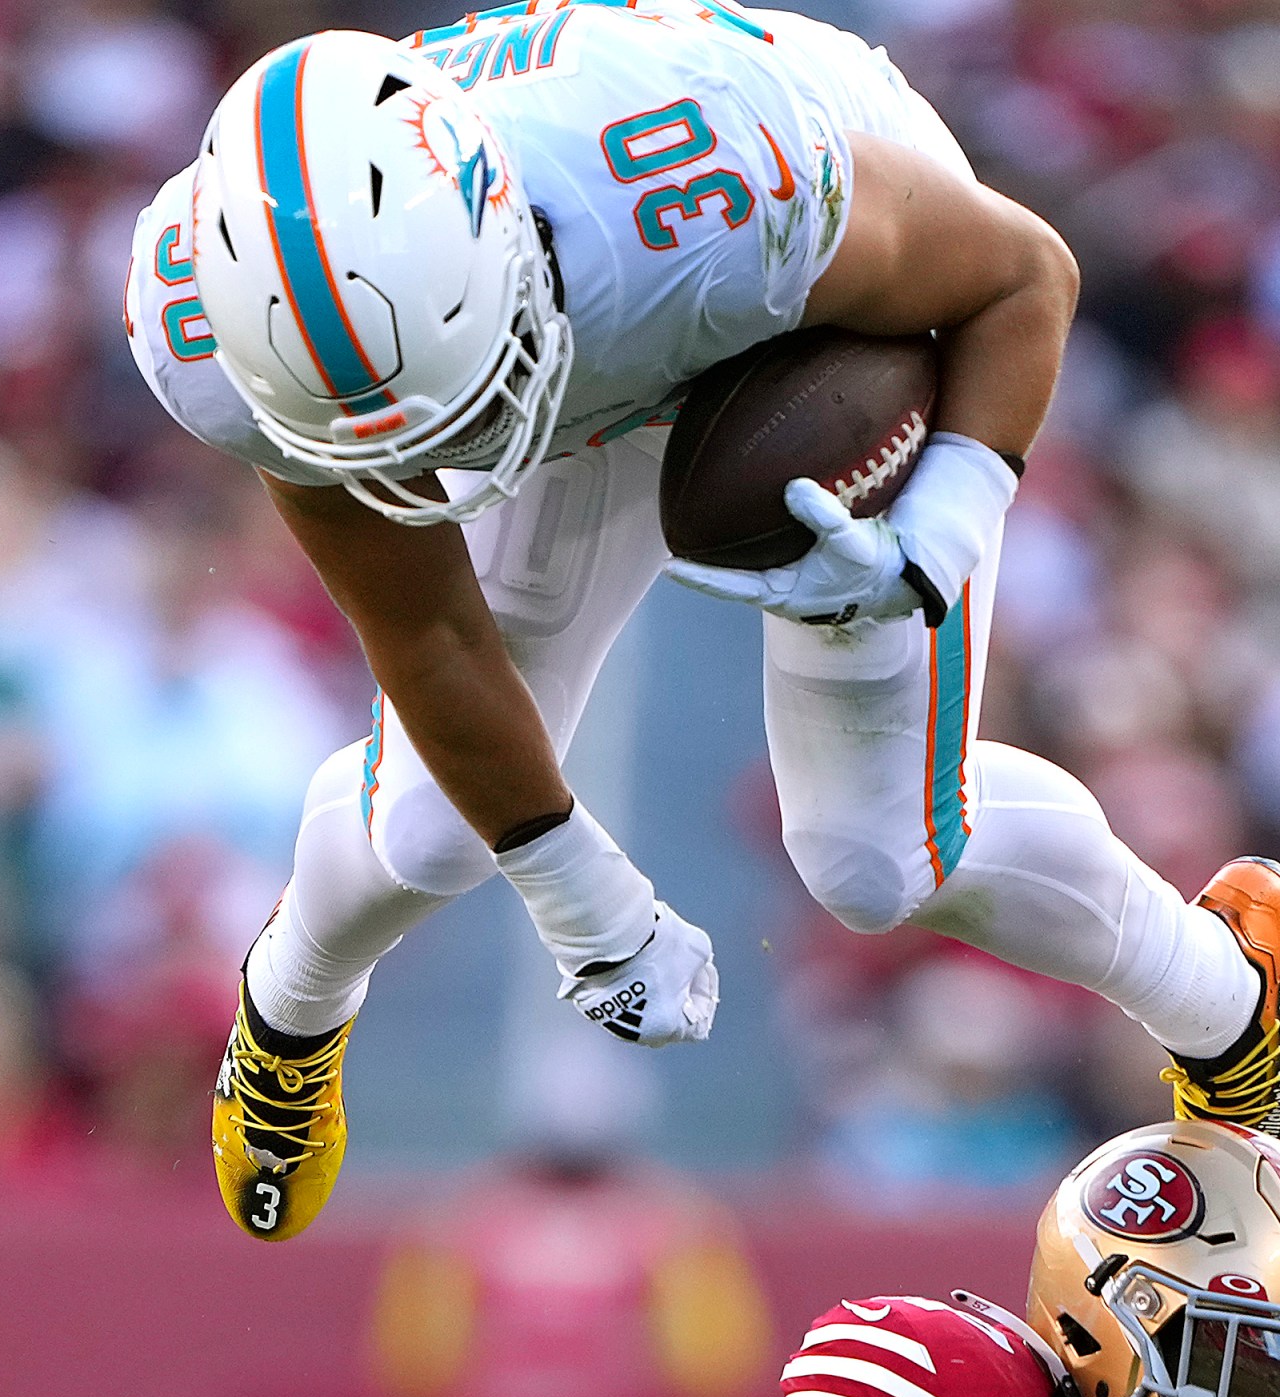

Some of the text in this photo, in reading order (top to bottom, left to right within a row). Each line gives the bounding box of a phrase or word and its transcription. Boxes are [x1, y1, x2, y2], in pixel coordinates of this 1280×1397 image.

[422, 8, 576, 92] ING
[600, 98, 756, 251] 30
[251, 1182, 281, 1230] 3
[972, 1300, 991, 1312] 57
